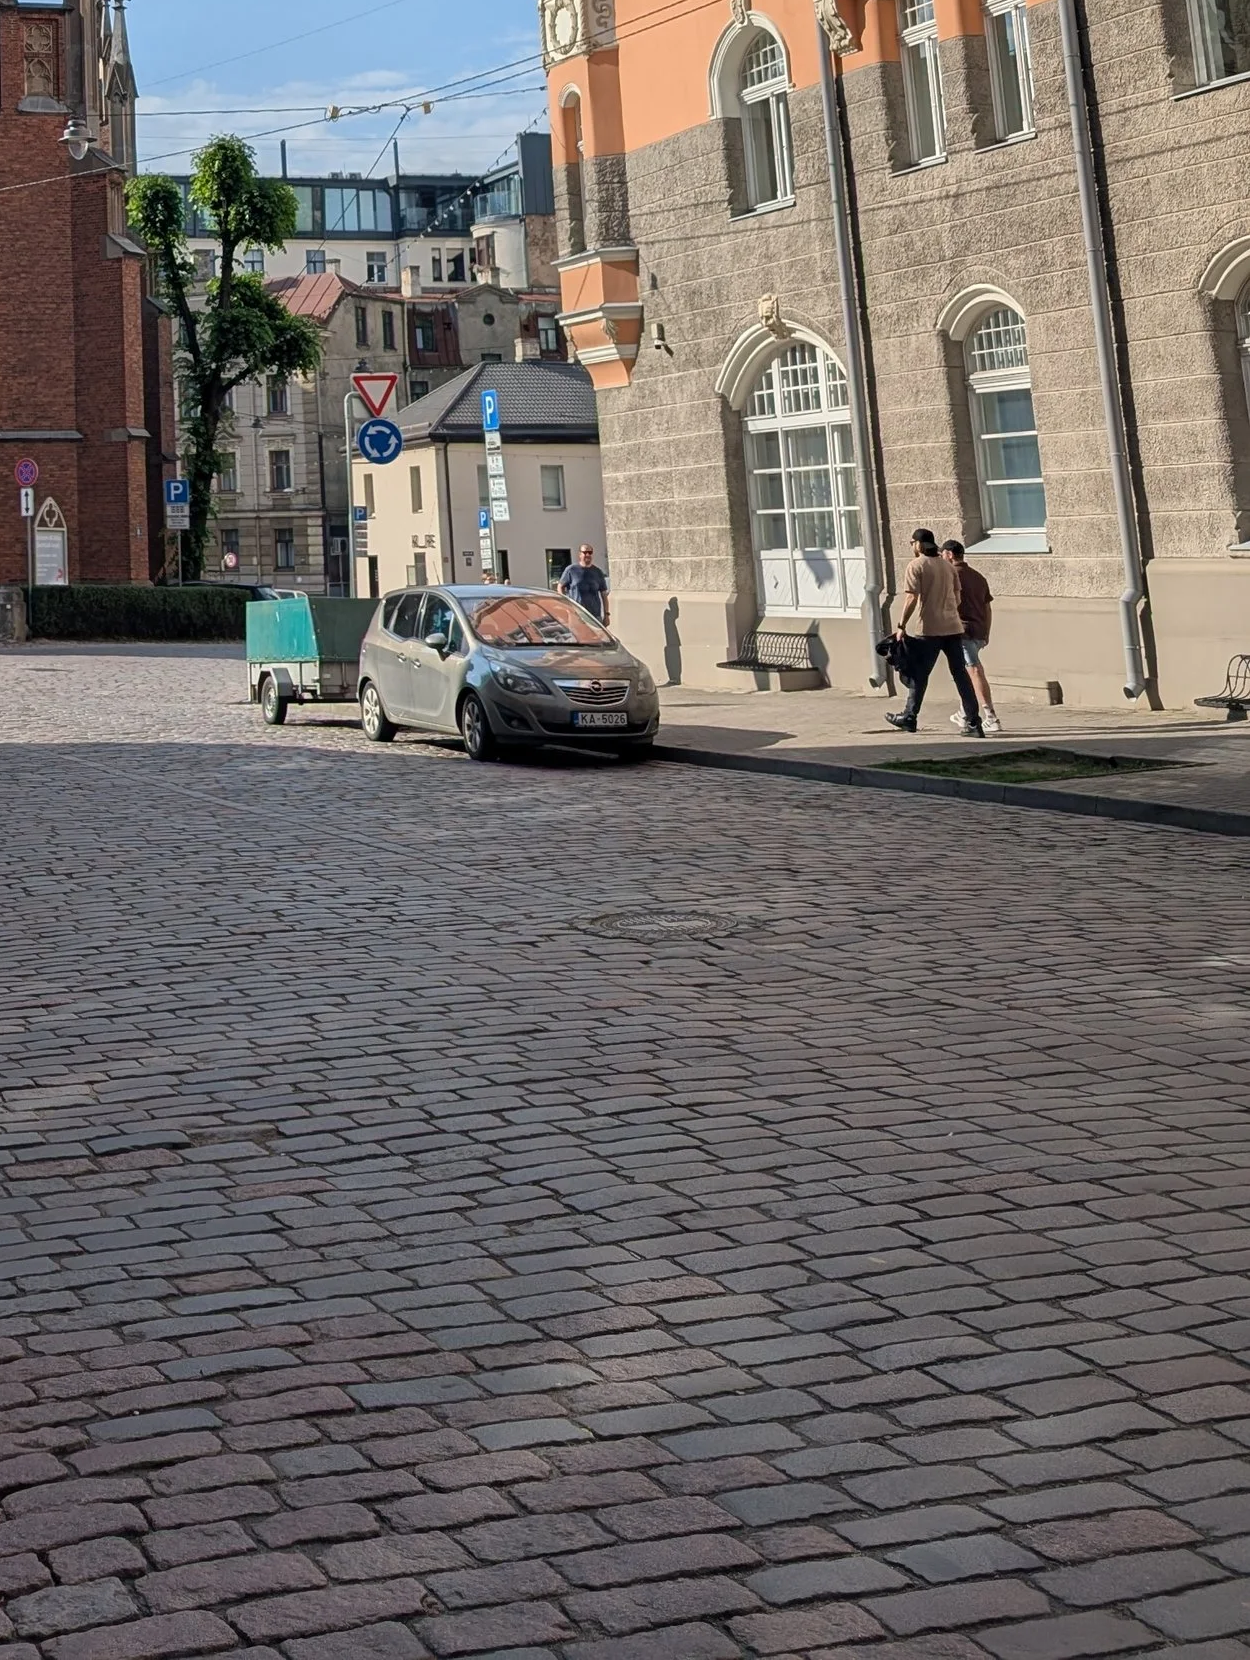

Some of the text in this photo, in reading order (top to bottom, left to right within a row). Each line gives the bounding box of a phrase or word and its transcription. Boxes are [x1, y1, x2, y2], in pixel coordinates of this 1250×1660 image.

[485, 396, 494, 425] P
[170, 482, 183, 501] P
[356, 507, 365, 519] P
[480, 512, 487, 526] P
[581, 714, 626, 724] KA-5026
